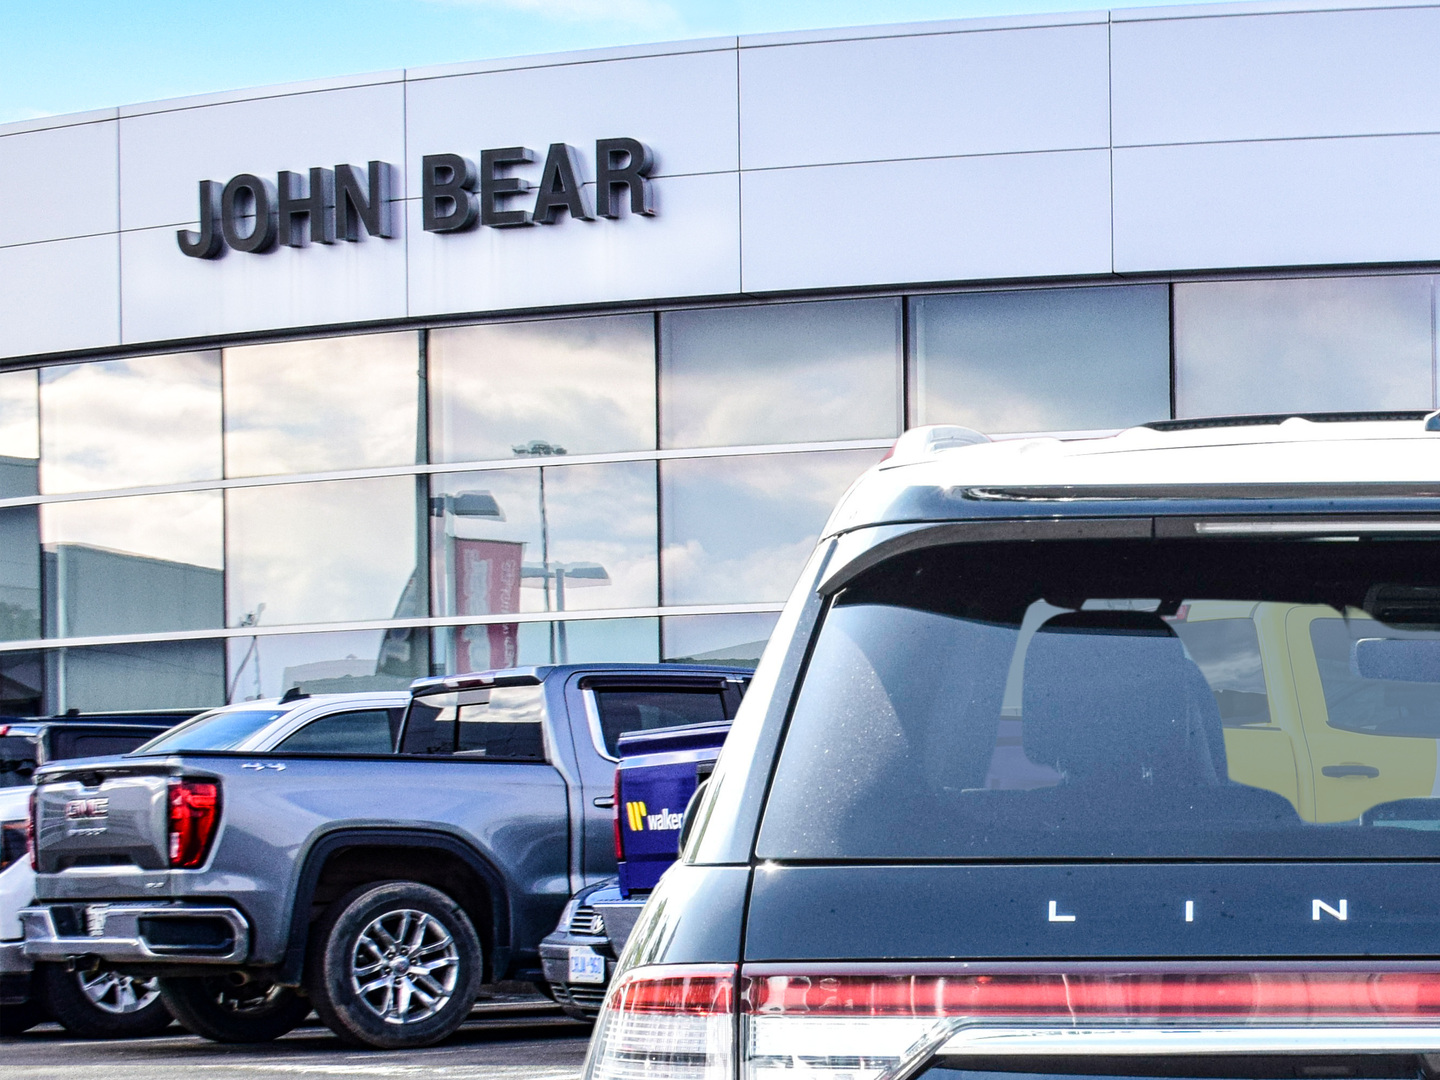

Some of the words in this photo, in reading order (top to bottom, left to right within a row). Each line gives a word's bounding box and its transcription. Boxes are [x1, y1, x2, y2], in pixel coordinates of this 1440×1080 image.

[176, 160, 392, 260] JOHN
[422, 137, 655, 234] BEAR
[647, 808, 684, 831] walker
